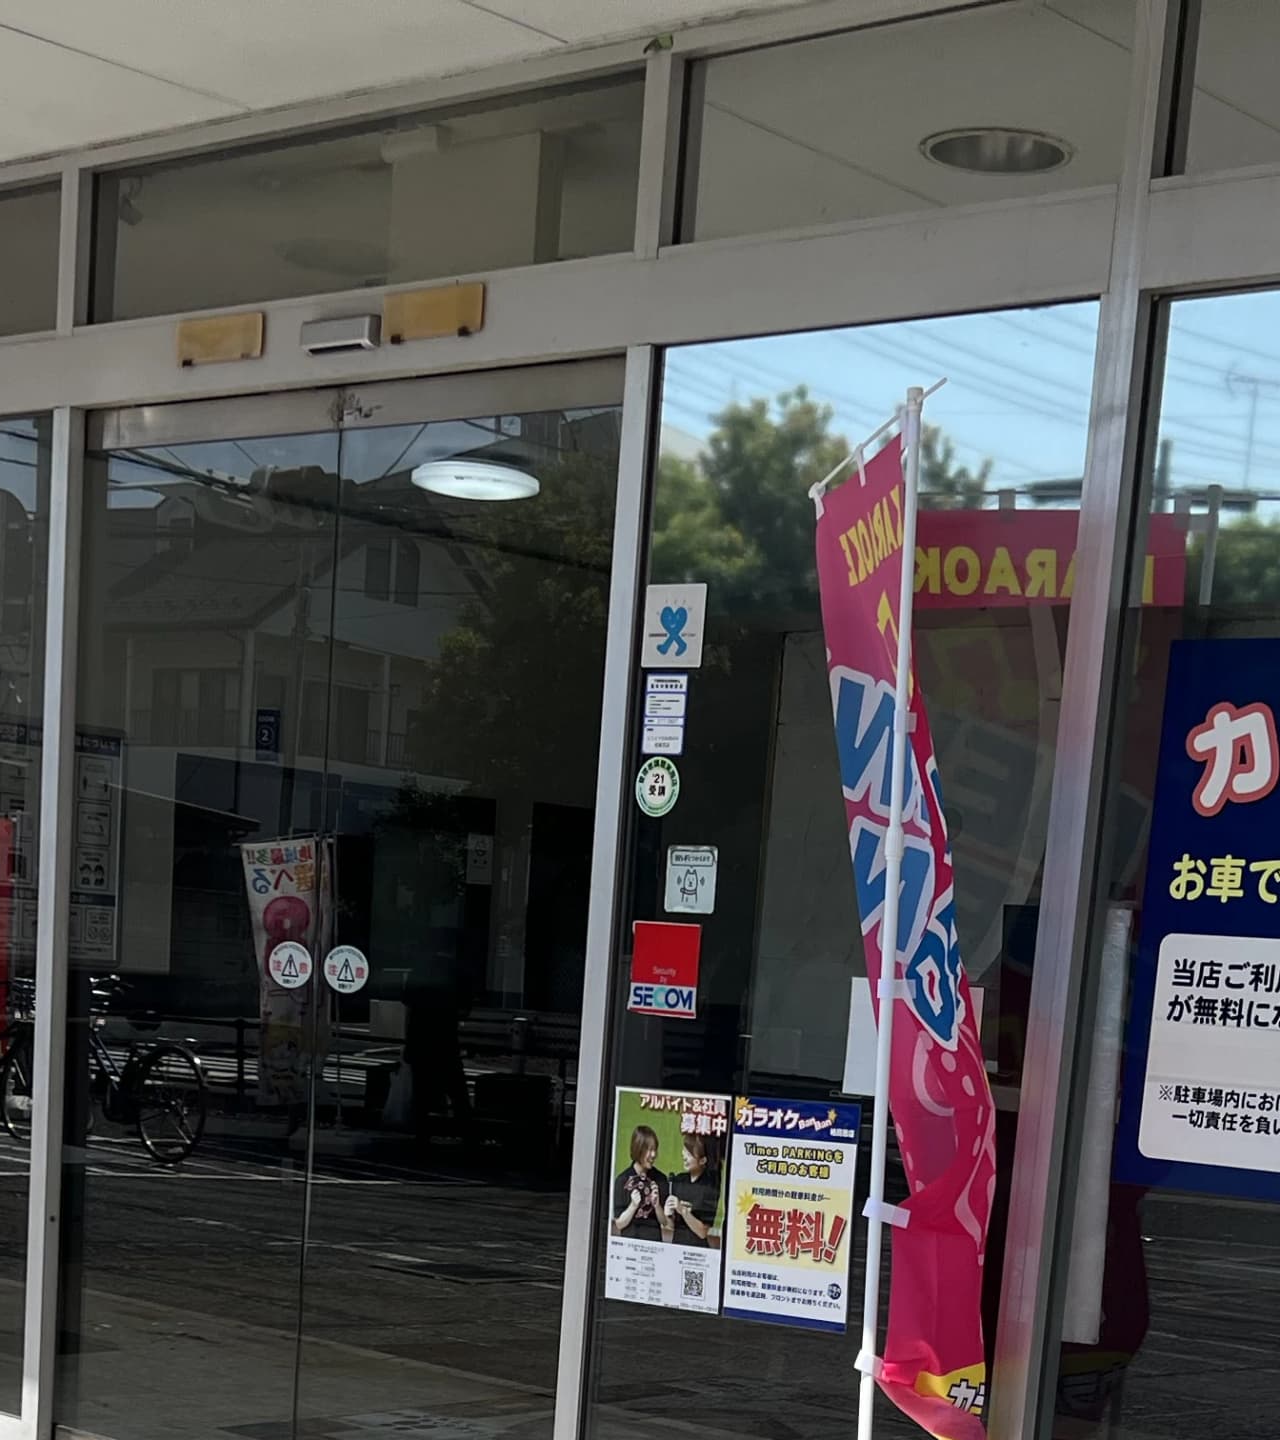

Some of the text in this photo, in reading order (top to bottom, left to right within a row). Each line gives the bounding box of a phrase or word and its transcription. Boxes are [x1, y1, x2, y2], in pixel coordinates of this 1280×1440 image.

[632, 986, 694, 1011] SECOM
[640, 1093, 727, 1116] アルバイト&社員
[680, 1112, 728, 1137] 募集中
[737, 1106, 800, 1131] カラオケ
[745, 1142, 779, 1157] Times
[756, 1158, 831, 1179] ご利用のお客様
[745, 1203, 847, 1263] 無料!
